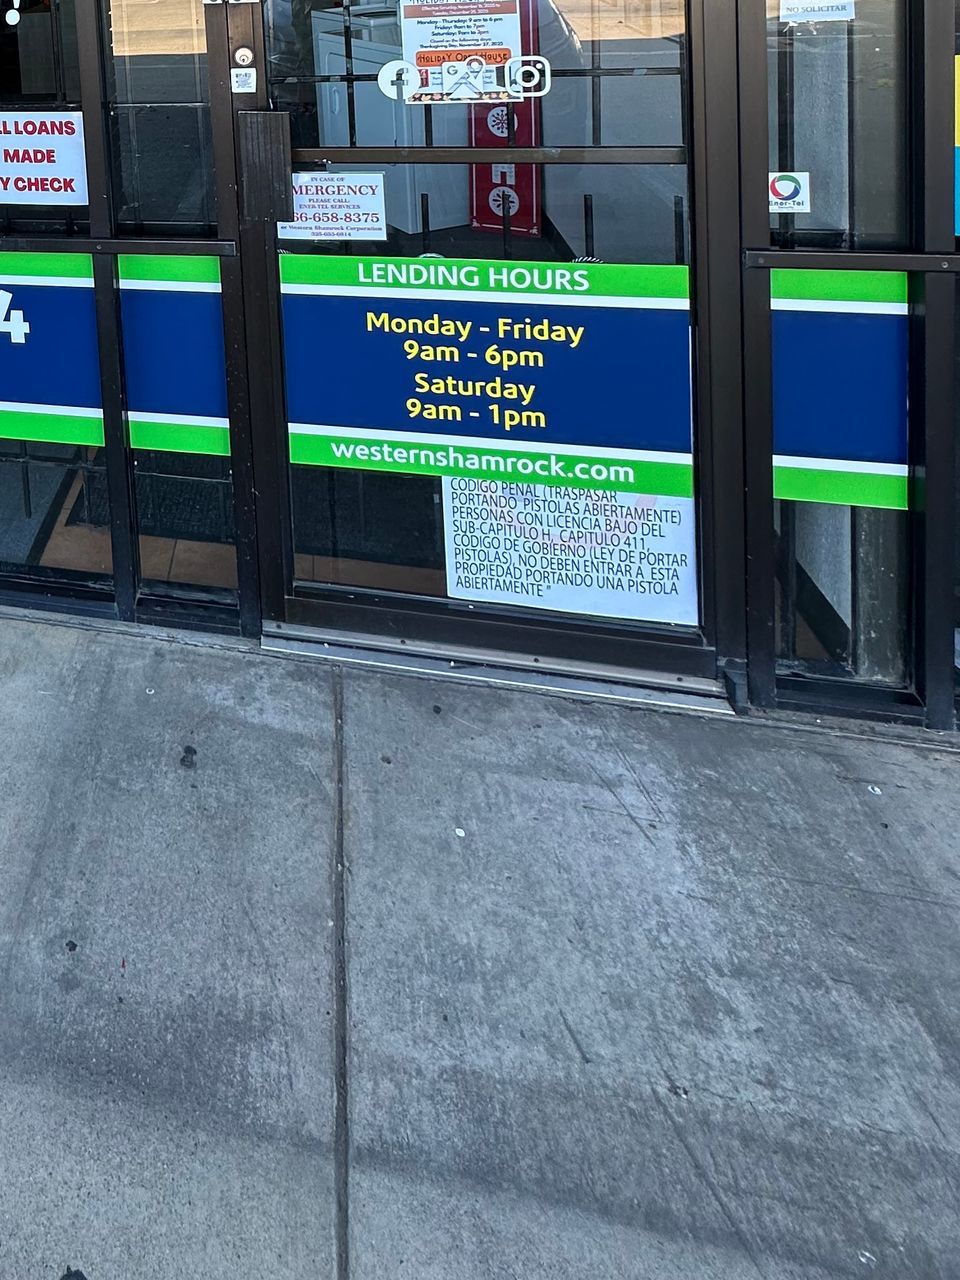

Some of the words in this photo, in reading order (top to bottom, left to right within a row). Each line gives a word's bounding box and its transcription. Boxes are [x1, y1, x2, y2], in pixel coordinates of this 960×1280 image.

[14, 120, 76, 136] LOANS
[3, 149, 56, 164] MADE
[14, 177, 76, 192] CHECK
[292, 185, 378, 196] MERGENCY
[357, 262, 480, 288] LENDING
[488, 267, 590, 291] HOURS
[366, 312, 472, 342] Monday
[498, 318, 584, 348] Friday
[403, 339, 460, 362] 9am
[484, 344, 544, 370] 6pm
[414, 372, 536, 406] Saturday
[406, 398, 462, 421] 9am
[488, 404, 546, 431] 1pm
[330, 441, 635, 483] westernshamrock.com
[501, 481, 539, 498] PENAL
[451, 492, 517, 510] PORTANDO
[524, 498, 580, 515] PISTOLAS
[582, 502, 682, 526] ABIERTAMENTE)
[452, 506, 514, 524] PERSONAS
[516, 511, 543, 526] CON
[546, 514, 602, 532] LICENCIA
[605, 518, 638, 536] BAJO
[641, 522, 666, 538] DEL
[453, 520, 539, 540] SUB-CAPITULO
[542, 528, 554, 544] H,
[559, 529, 621, 548] CAPITULO
[623, 536, 650, 554] 411,
[454, 547, 516, 566] PISTOLAS),
[518, 552, 537, 568] NO
[540, 556, 580, 574] DEBEN
[584, 560, 632, 578] ENTRAR
[636, 565, 644, 579] A
[651, 566, 680, 581] ESTA
[504, 538, 520, 552] DE
[522, 540, 586, 558] GOBIERNO
[590, 544, 615, 562] (LEY
[618, 548, 635, 564] DE
[640, 551, 688, 568] PORTAR
[456, 561, 522, 580] PROPIEDAD
[526, 568, 594, 588] PORTANDO
[596, 574, 624, 592] UNA
[628, 579, 678, 596] PISTOLA
[456, 575, 544, 596] ABIERTAMENTE
